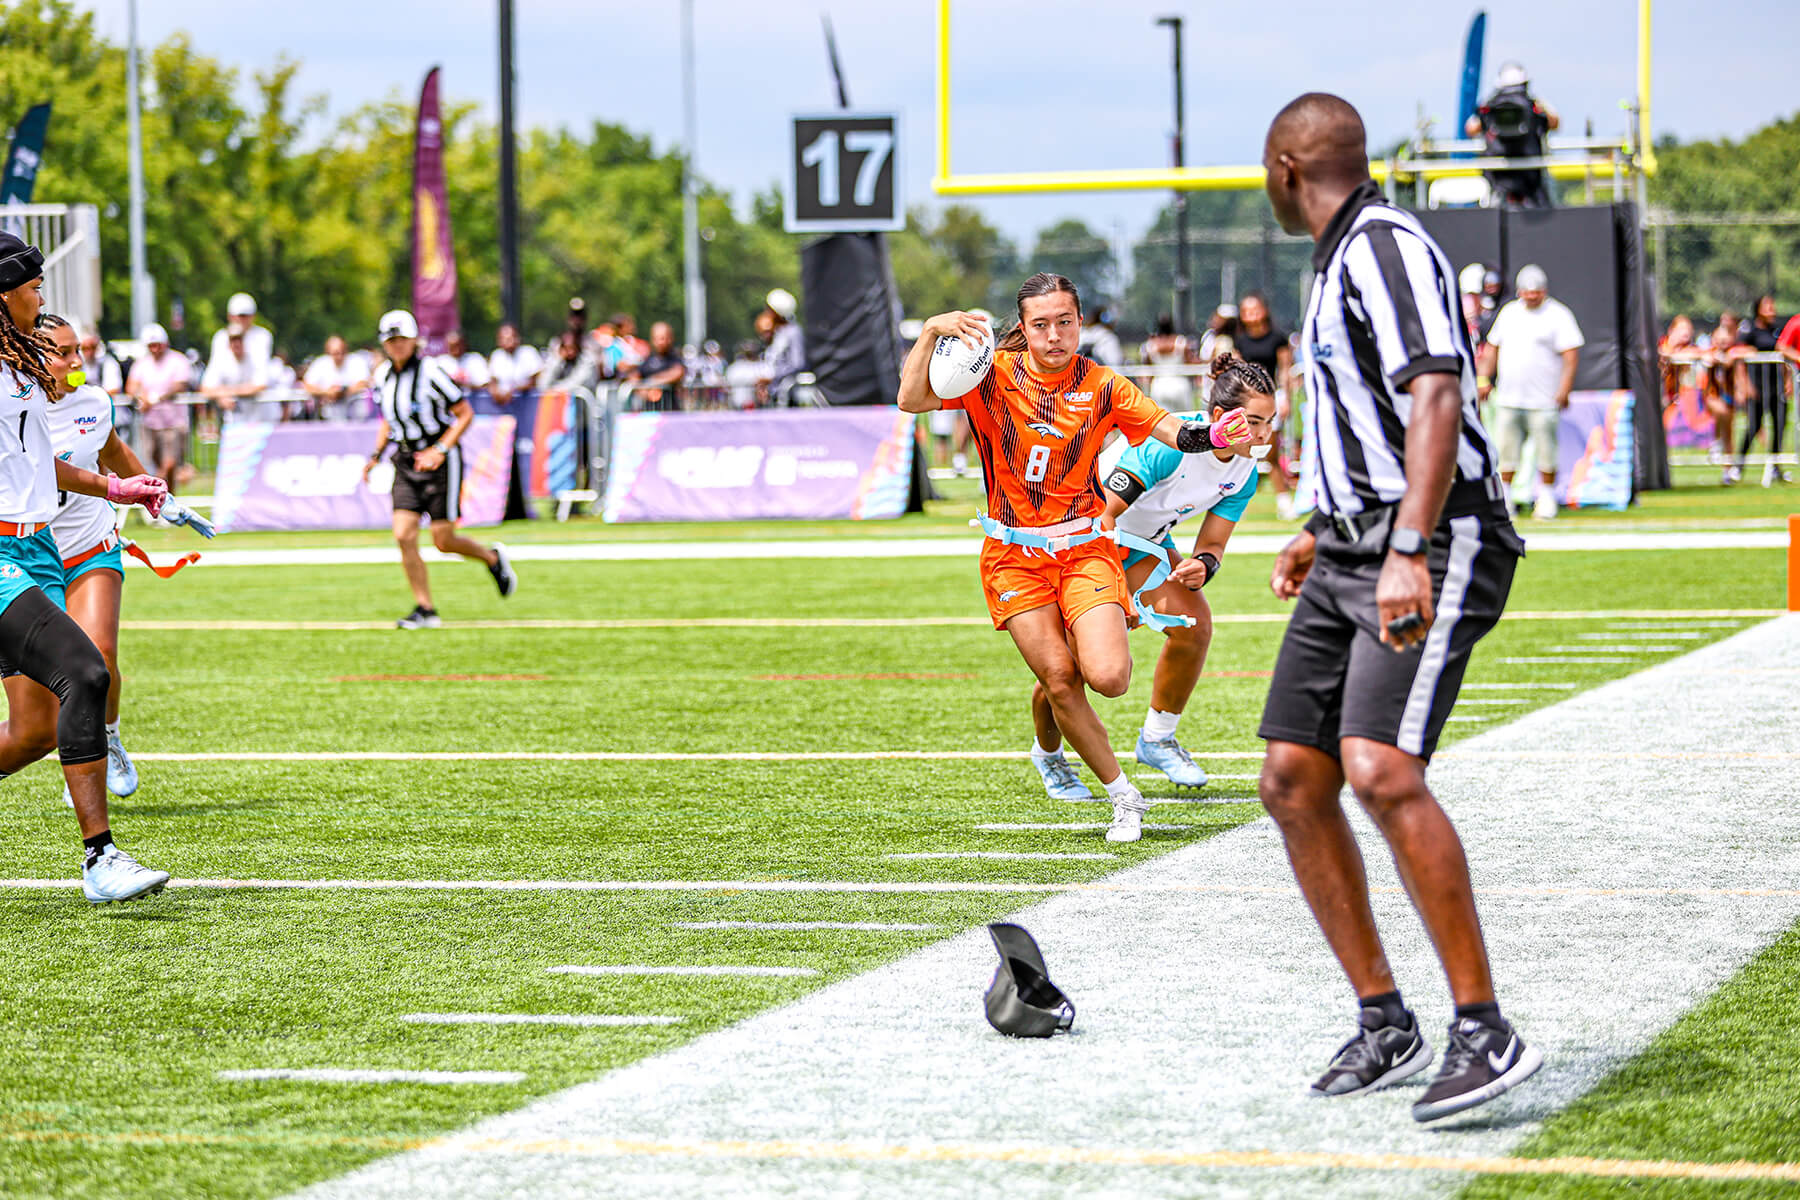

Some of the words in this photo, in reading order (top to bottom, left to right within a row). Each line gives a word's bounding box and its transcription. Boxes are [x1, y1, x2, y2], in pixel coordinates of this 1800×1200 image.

[802, 130, 892, 206] 17
[969, 346, 991, 374] Wilson
[79, 416, 97, 424] FLAG
[1025, 444, 1051, 482] 8
